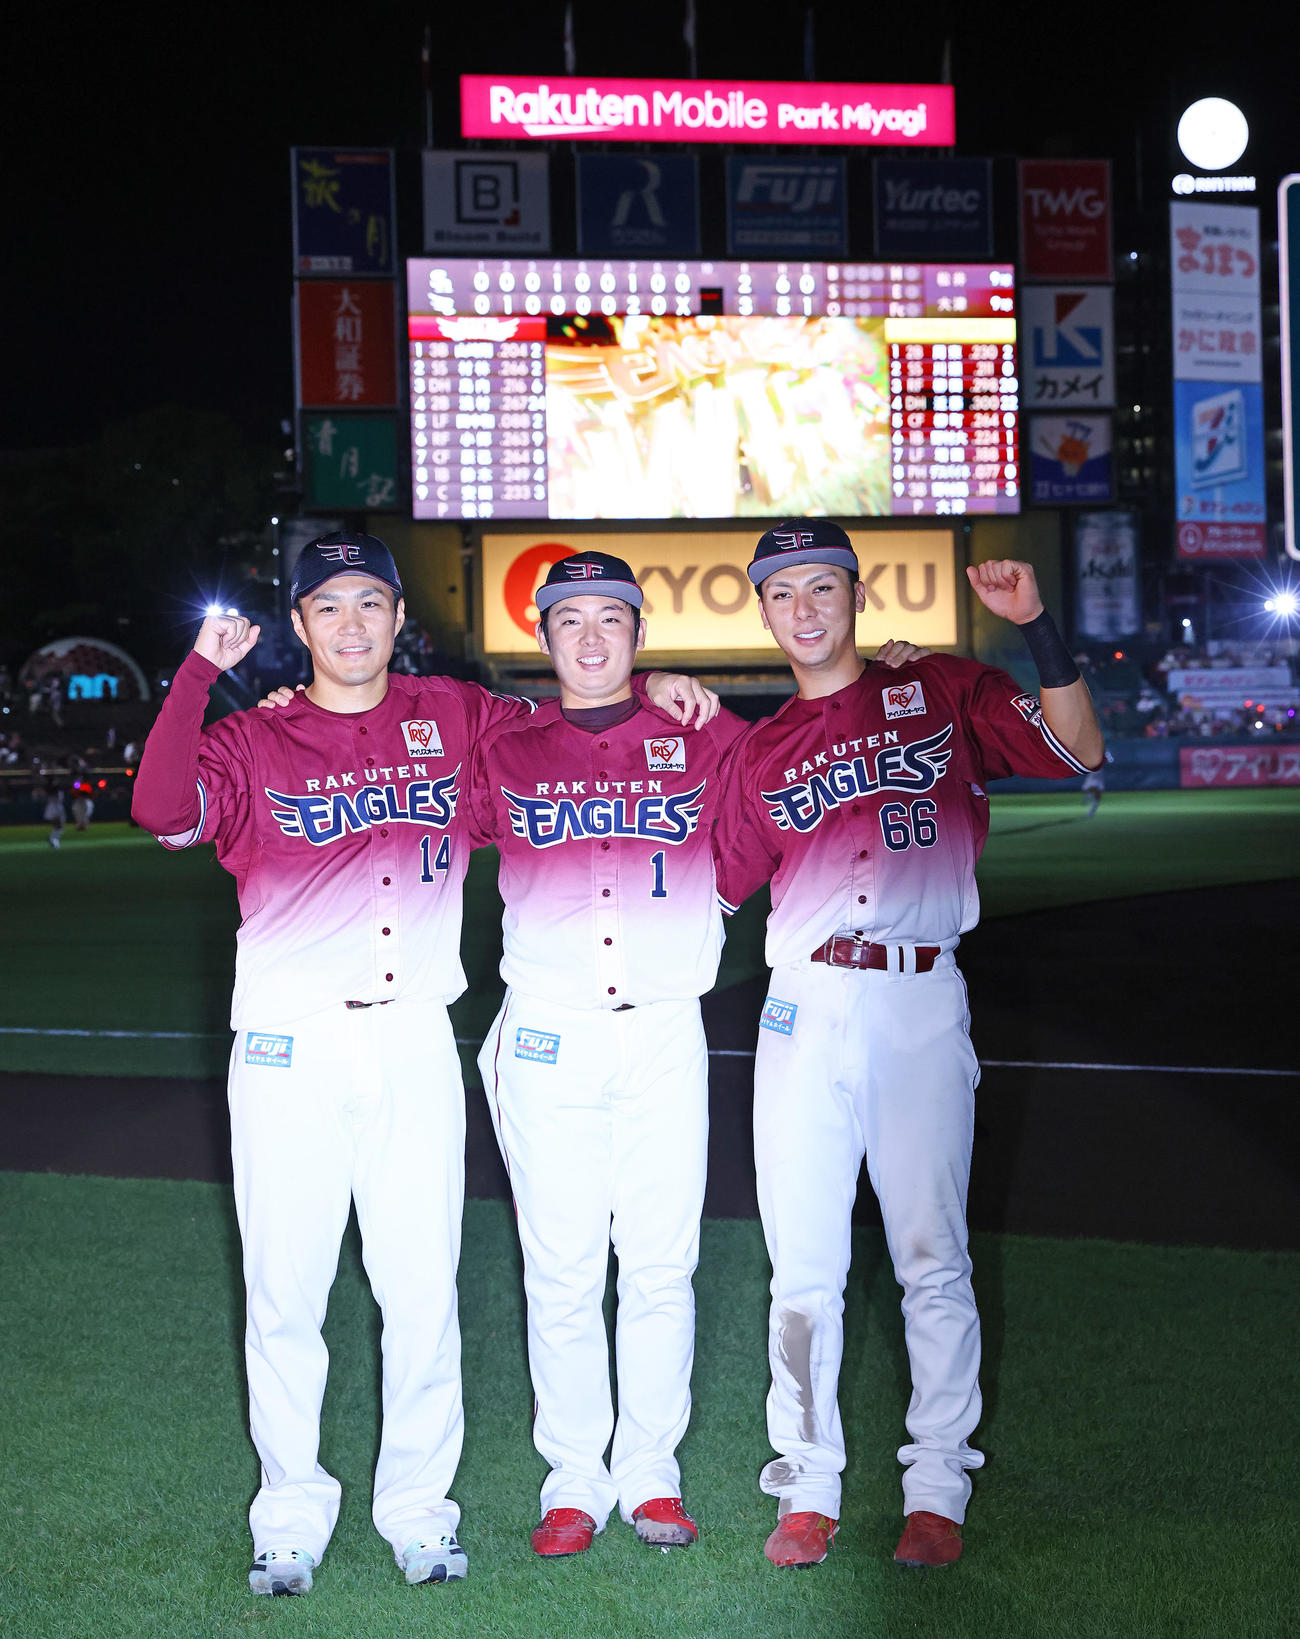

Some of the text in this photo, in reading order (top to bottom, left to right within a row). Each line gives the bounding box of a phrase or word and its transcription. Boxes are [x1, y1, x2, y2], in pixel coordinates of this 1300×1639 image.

[488, 85, 928, 137] Rakuten Mobile Park Miyagi
[473, 174, 500, 211] B
[735, 165, 839, 212] Fuji
[883, 177, 981, 213] Yurtec
[1022, 187, 1106, 220] TWG
[473, 271, 490, 292] 0
[499, 271, 515, 292] 0
[524, 271, 541, 293] 0
[552, 272, 562, 292] 1
[575, 271, 591, 293] 0
[599, 271, 616, 293] 0
[628, 272, 637, 293] 1
[650, 272, 666, 294] 0
[674, 272, 691, 294] 0
[737, 273, 753, 294] 2
[775, 273, 791, 294] 6
[799, 273, 815, 294] 0
[474, 294, 490, 315] 0
[503, 294, 512, 315] 1
[525, 294, 541, 315] 0
[550, 294, 566, 315] 0
[575, 295, 592, 316] 0
[600, 295, 617, 316] 0
[626, 295, 641, 316] 2
[651, 295, 667, 316] 0
[738, 295, 753, 316] 3
[802, 296, 812, 316] 1
[414, 342, 423, 358] 1
[892, 343, 899, 358] 1
[413, 359, 425, 376] 2
[891, 360, 902, 377] 2
[1035, 375, 1103, 398] カメイ
[414, 395, 426, 411] 4
[891, 395, 902, 410] 4
[415, 448, 428, 465] 7
[893, 447, 904, 463] 7
[436, 484, 449, 501] C
[639, 562, 938, 615] KYOKU
[886, 706, 926, 718] アイリスオーヤマ
[409, 748, 443, 756] アイリスオーヤマ
[783, 730, 900, 784] RAKUTEN
[648, 762, 685, 770] アイリスオーヤマ
[305, 763, 429, 792] RAKUTEN
[535, 779, 663, 796] RAKUTEN
[761, 722, 953, 833] EAGLES
[264, 761, 463, 847] EAGLES
[500, 777, 707, 849] EAGLES
[878, 798, 938, 853] 66
[419, 834, 451, 884] 14
[650, 850, 669, 900] 1
[764, 1000, 795, 1022] Fuji
[249, 1035, 289, 1056] Fuji
[519, 1030, 560, 1052] Fuji
